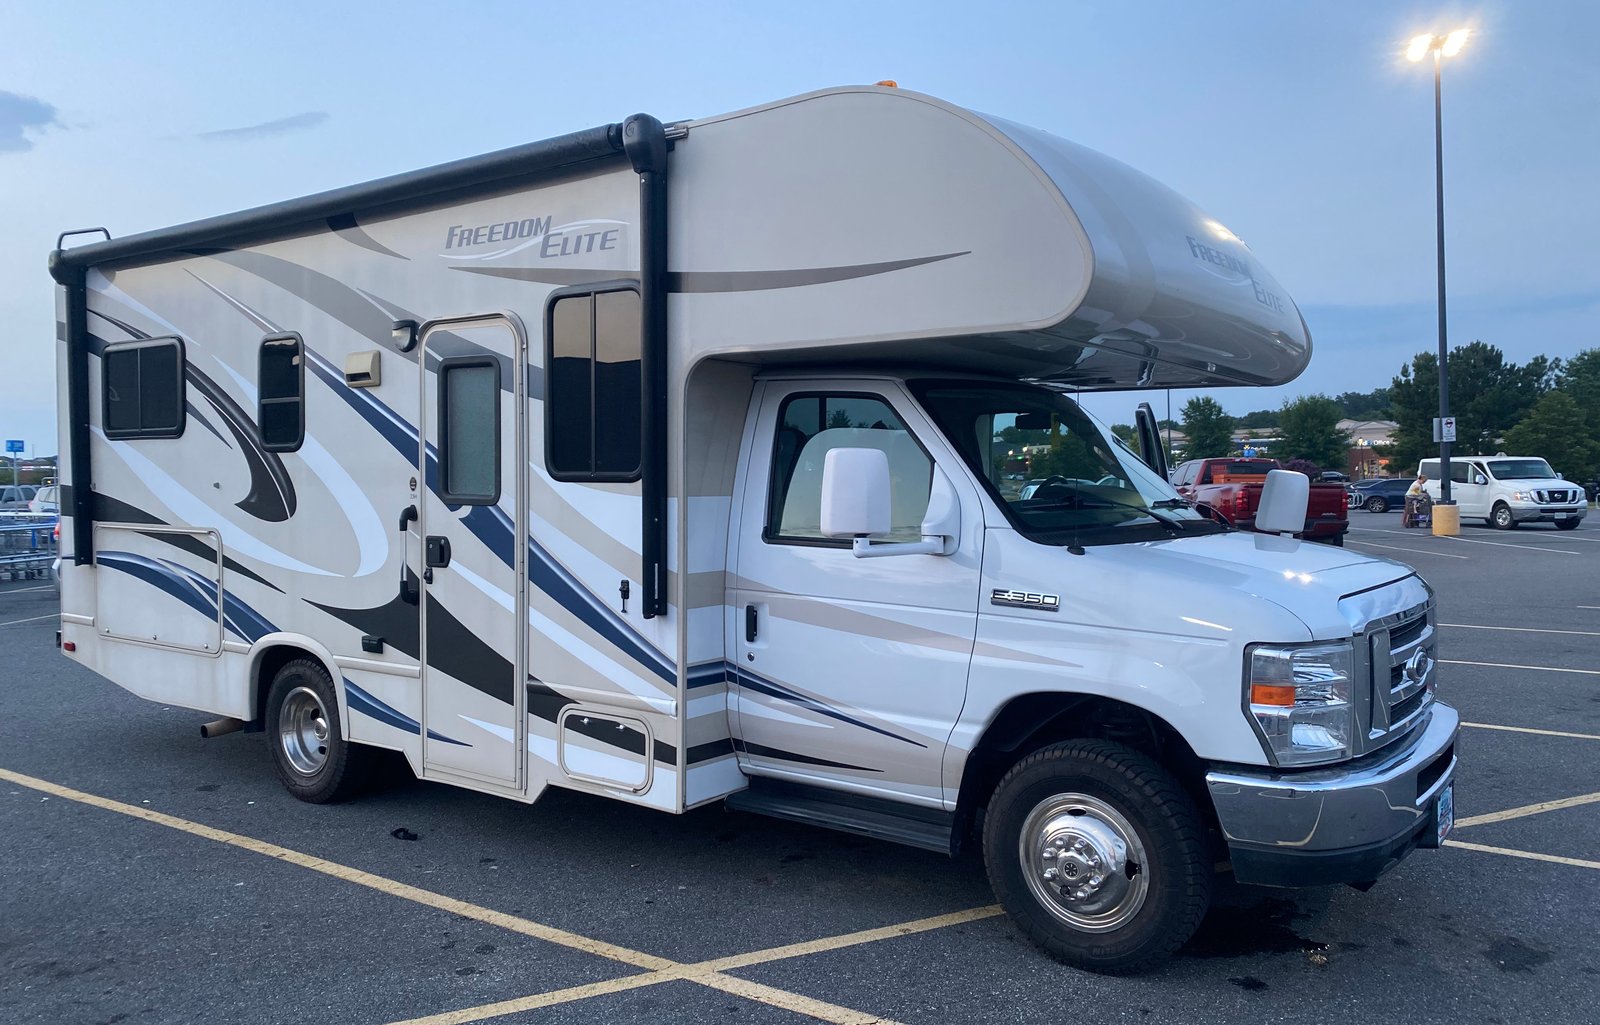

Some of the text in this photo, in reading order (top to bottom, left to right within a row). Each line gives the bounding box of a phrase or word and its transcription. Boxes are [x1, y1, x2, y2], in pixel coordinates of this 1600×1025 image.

[445, 215, 552, 249] FREEDOM
[539, 229, 619, 259] ELITE
[1250, 276, 1285, 314] ELITE
[991, 588, 1059, 606] E-350
